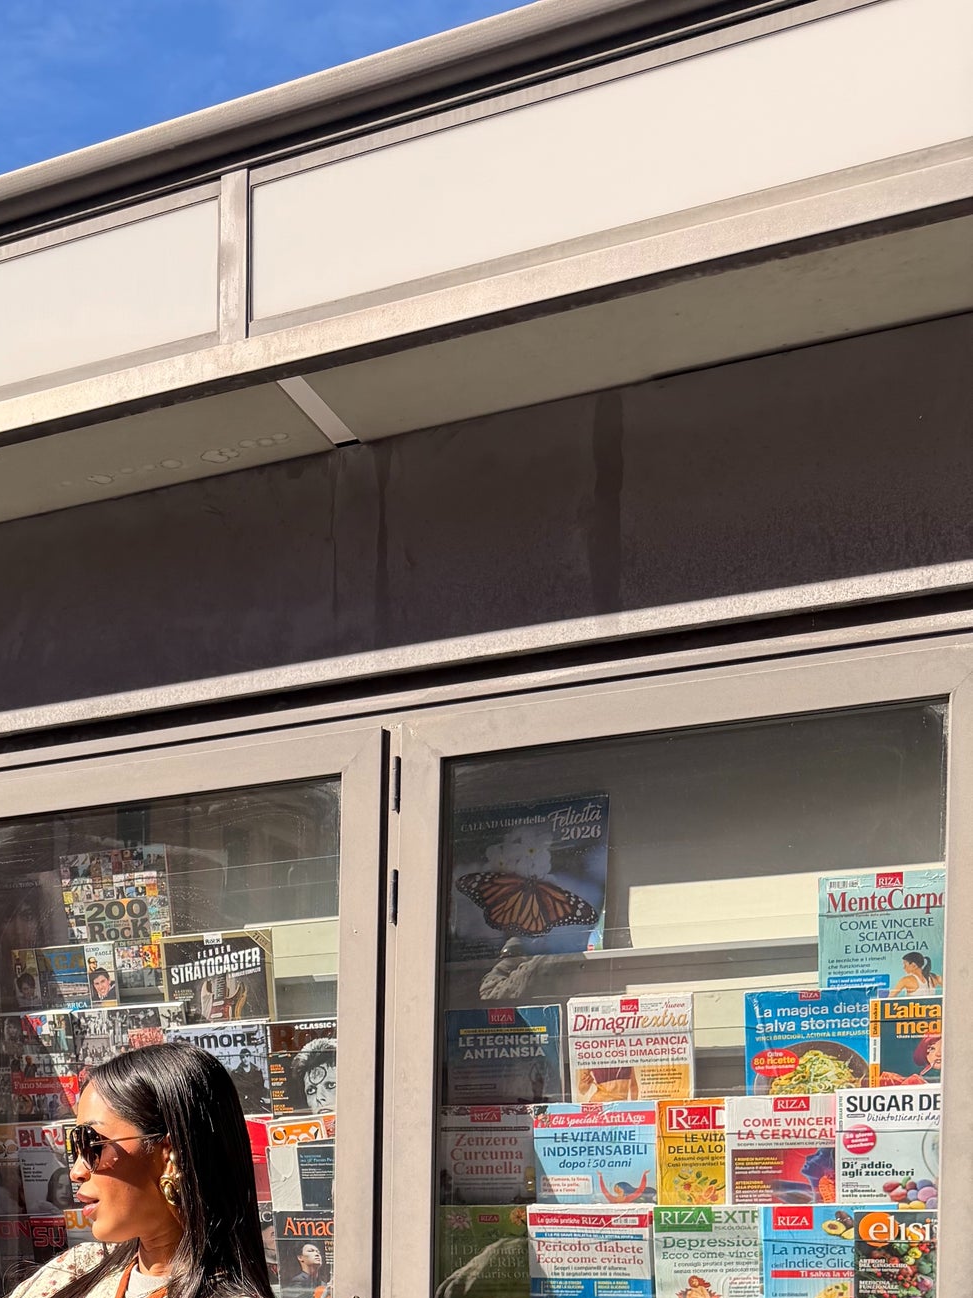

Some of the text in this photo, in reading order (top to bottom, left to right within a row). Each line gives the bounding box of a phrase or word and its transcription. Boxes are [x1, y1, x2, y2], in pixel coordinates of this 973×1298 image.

[522, 802, 603, 832] della Felicità
[561, 824, 601, 841] 2026
[878, 877, 901, 886] RIZA
[87, 899, 147, 920] 200
[840, 917, 934, 931] COME VINCERE
[859, 930, 914, 941] SCIATICA
[197, 944, 231, 959] FENDER
[845, 941, 929, 954] E LOMBALGIA
[171, 947, 261, 985] STRATOCASTER
[755, 1002, 869, 1018] La magica dieta
[884, 1003, 941, 1018] L'altra
[299, 1022, 331, 1030] CLASSIC
[756, 1017, 869, 1034] salva stomaco
[896, 1020, 941, 1035] med
[459, 1033, 549, 1047] LE TECNICHE
[575, 1036, 689, 1049] SGONFIA LA PANCIA
[464, 1047, 545, 1060] ANTIANSIA
[577, 1047, 686, 1060] SOLO DIMAGRISCI
[767, 1057, 796, 1065] ricette
[777, 1100, 808, 1109] RIZA
[846, 1094, 941, 1112] SUGAR DE
[743, 1118, 782, 1127] COME
[867, 1112, 924, 1122] Disintossicarsi
[455, 1133, 518, 1148] Zenzero
[553, 1130, 636, 1143] LE VITAMINE
[685, 1133, 697, 1143] LE
[737, 1131, 757, 1140] LA
[450, 1148, 523, 1161] Curcuma
[543, 1144, 648, 1157] INDISPENSABILI
[668, 1145, 702, 1155] DELLA
[453, 1162, 522, 1175] Cannella
[558, 1158, 632, 1170] dopo 50 anni
[842, 1161, 857, 1169] Di'
[842, 1169, 915, 1178] agli zuccheri
[582, 1217, 605, 1225] RIZA
[777, 1216, 809, 1226] RIZA
[537, 1241, 643, 1253] Pericolo diabete
[772, 1245, 842, 1257] La magica
[537, 1254, 644, 1265] Ecco come evitarlo
[662, 1251, 689, 1259] Ecco
